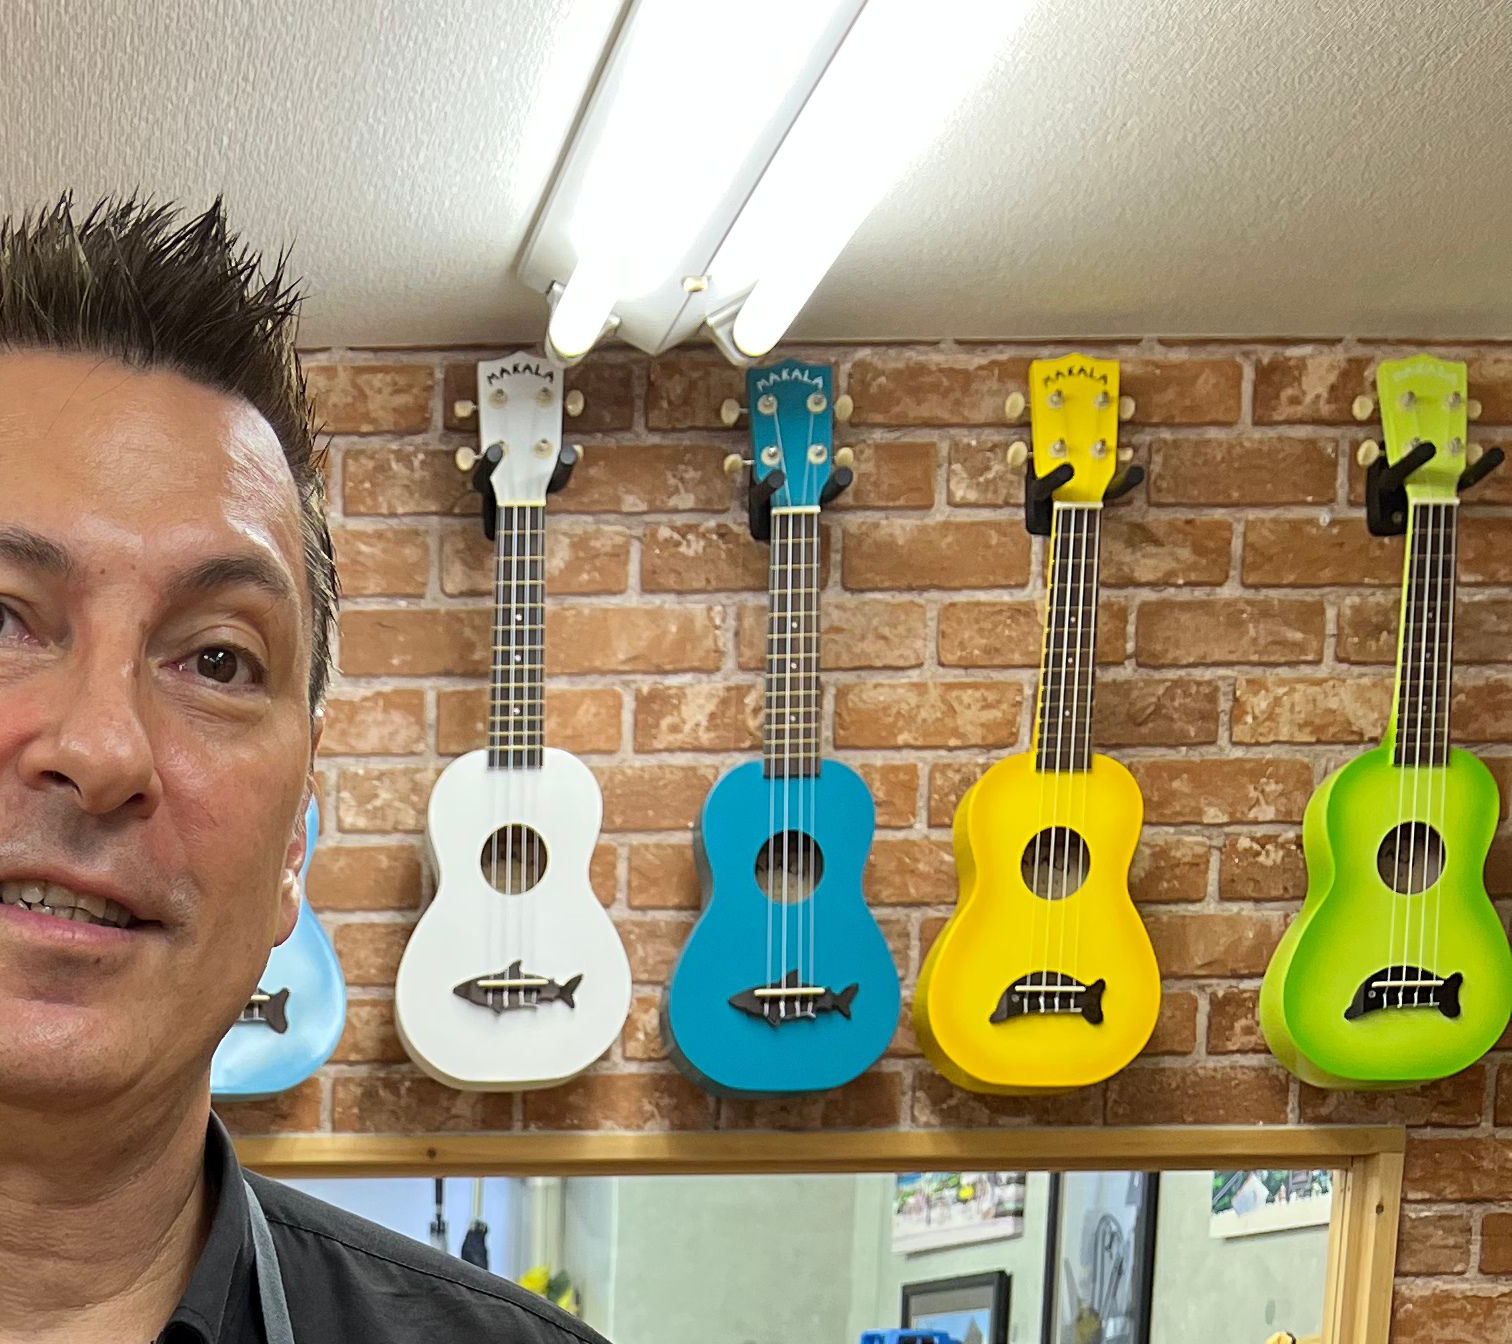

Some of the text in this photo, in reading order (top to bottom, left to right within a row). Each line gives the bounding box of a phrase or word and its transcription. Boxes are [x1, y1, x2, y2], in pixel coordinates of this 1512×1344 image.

[486, 362, 554, 386] MAKALA
[755, 367, 824, 392] MAKALA
[1043, 364, 1108, 388] MAKALA
